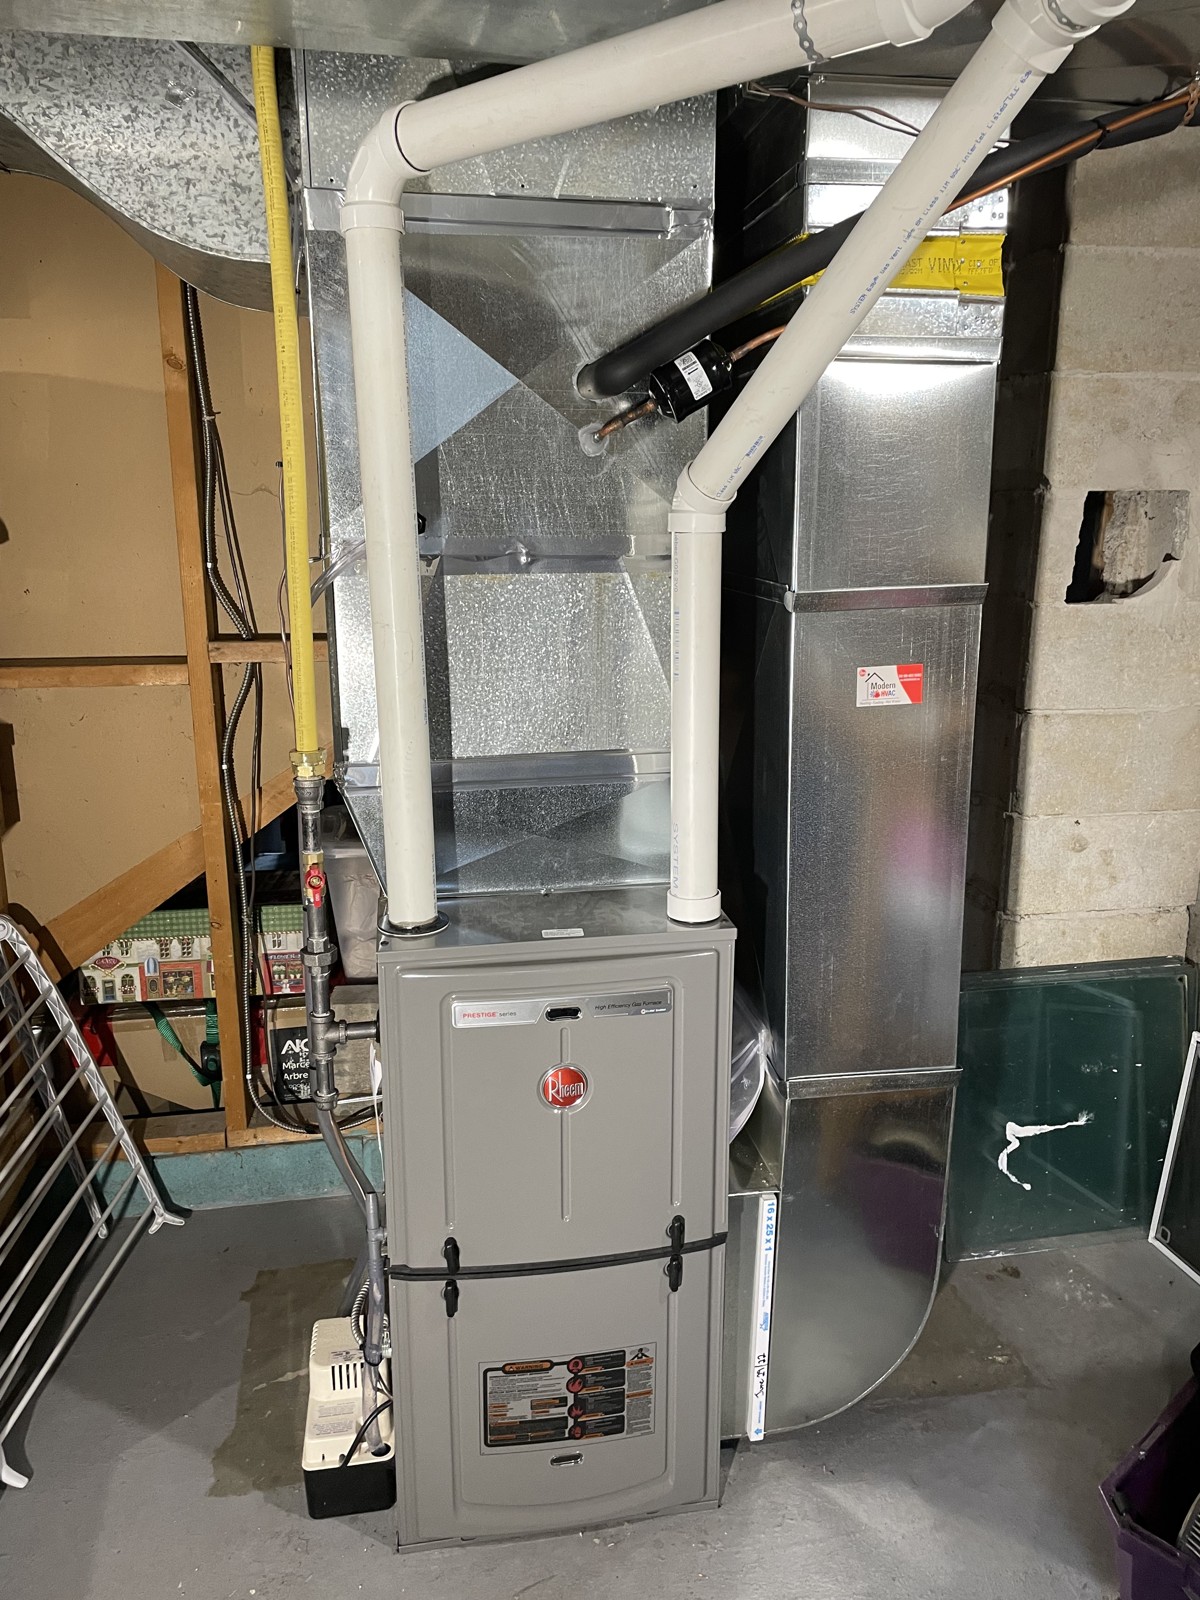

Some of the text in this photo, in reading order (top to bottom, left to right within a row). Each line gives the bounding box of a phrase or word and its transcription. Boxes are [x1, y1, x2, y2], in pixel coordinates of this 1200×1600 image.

[871, 682, 896, 690] Modern
[284, 1072, 309, 1081] Arbre
[549, 1071, 584, 1102] Rheem
[767, 1202, 775, 1214] 16
[765, 1223, 774, 1236] 25
